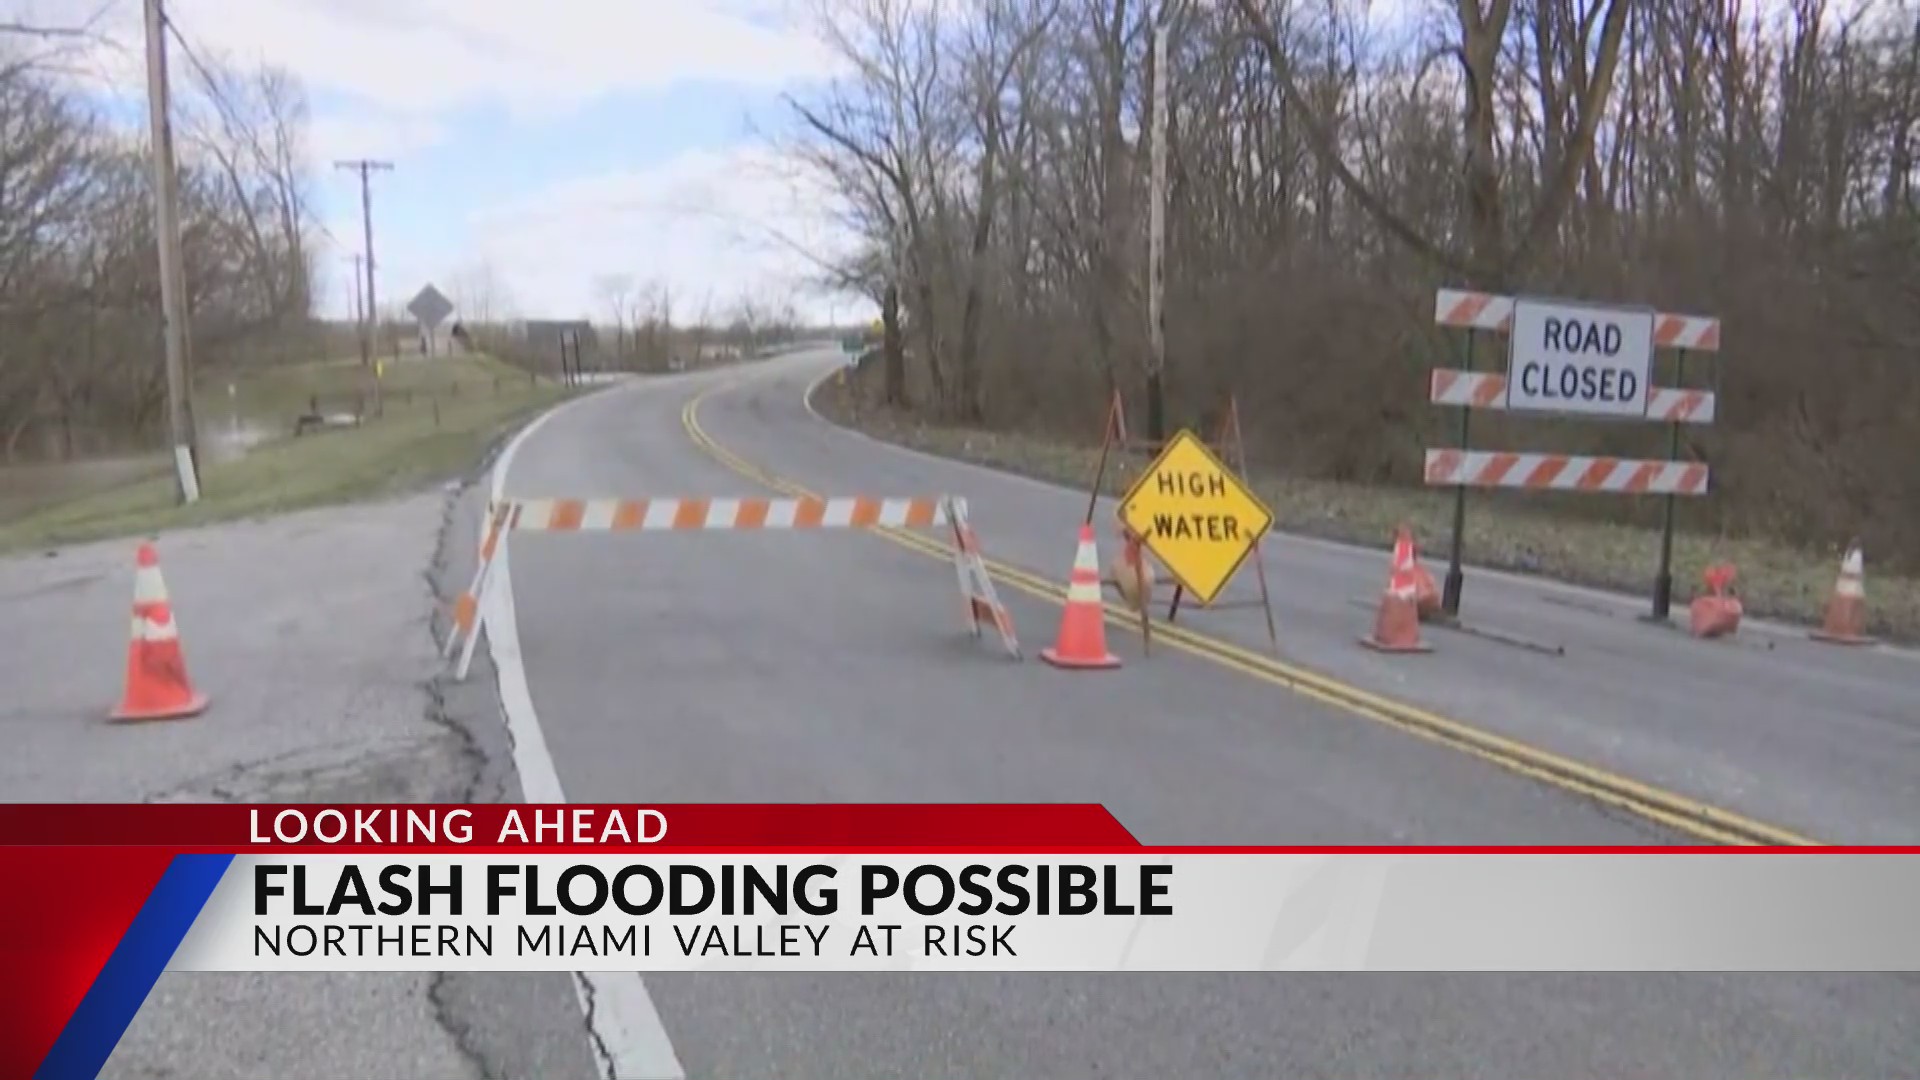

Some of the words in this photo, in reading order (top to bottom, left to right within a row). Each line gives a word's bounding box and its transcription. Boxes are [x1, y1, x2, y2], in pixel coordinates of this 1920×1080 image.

[1543, 317, 1621, 357] ROAD
[1522, 363, 1637, 402] CLOSED
[1157, 471, 1226, 497] HIGH
[1154, 513, 1240, 542] WATER
